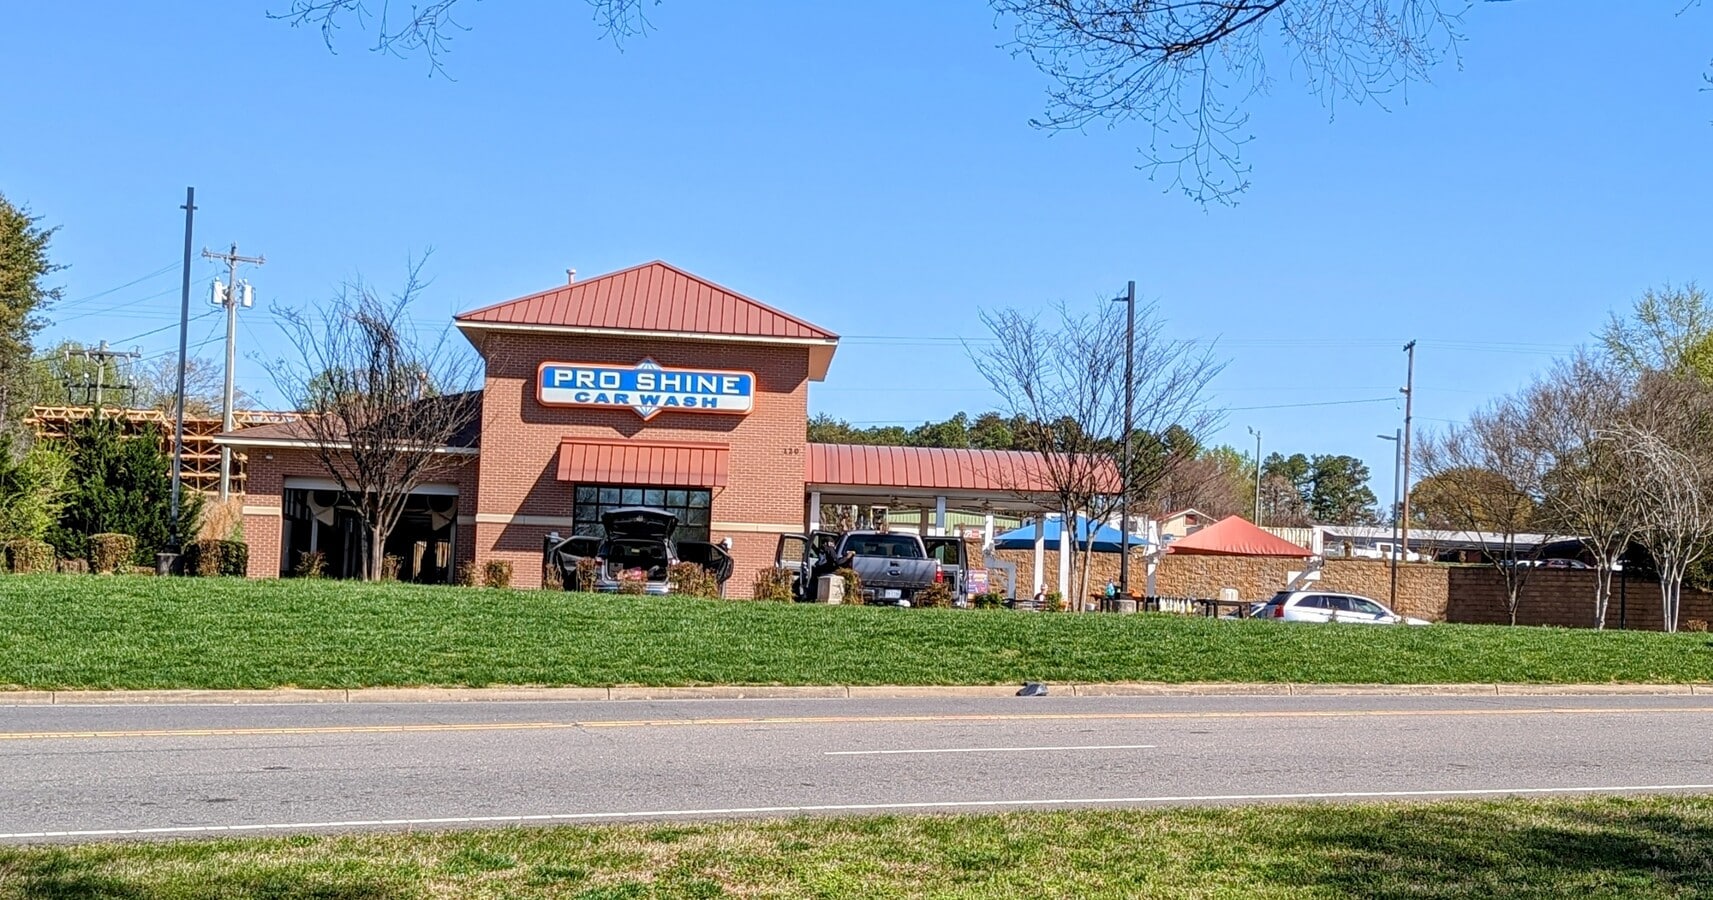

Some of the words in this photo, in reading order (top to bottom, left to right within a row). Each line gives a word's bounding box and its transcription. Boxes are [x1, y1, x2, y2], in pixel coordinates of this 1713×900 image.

[554, 369, 620, 389] PRO
[636, 373, 740, 394] SHINE
[574, 391, 630, 405] CAR
[639, 394, 718, 408] WASH
